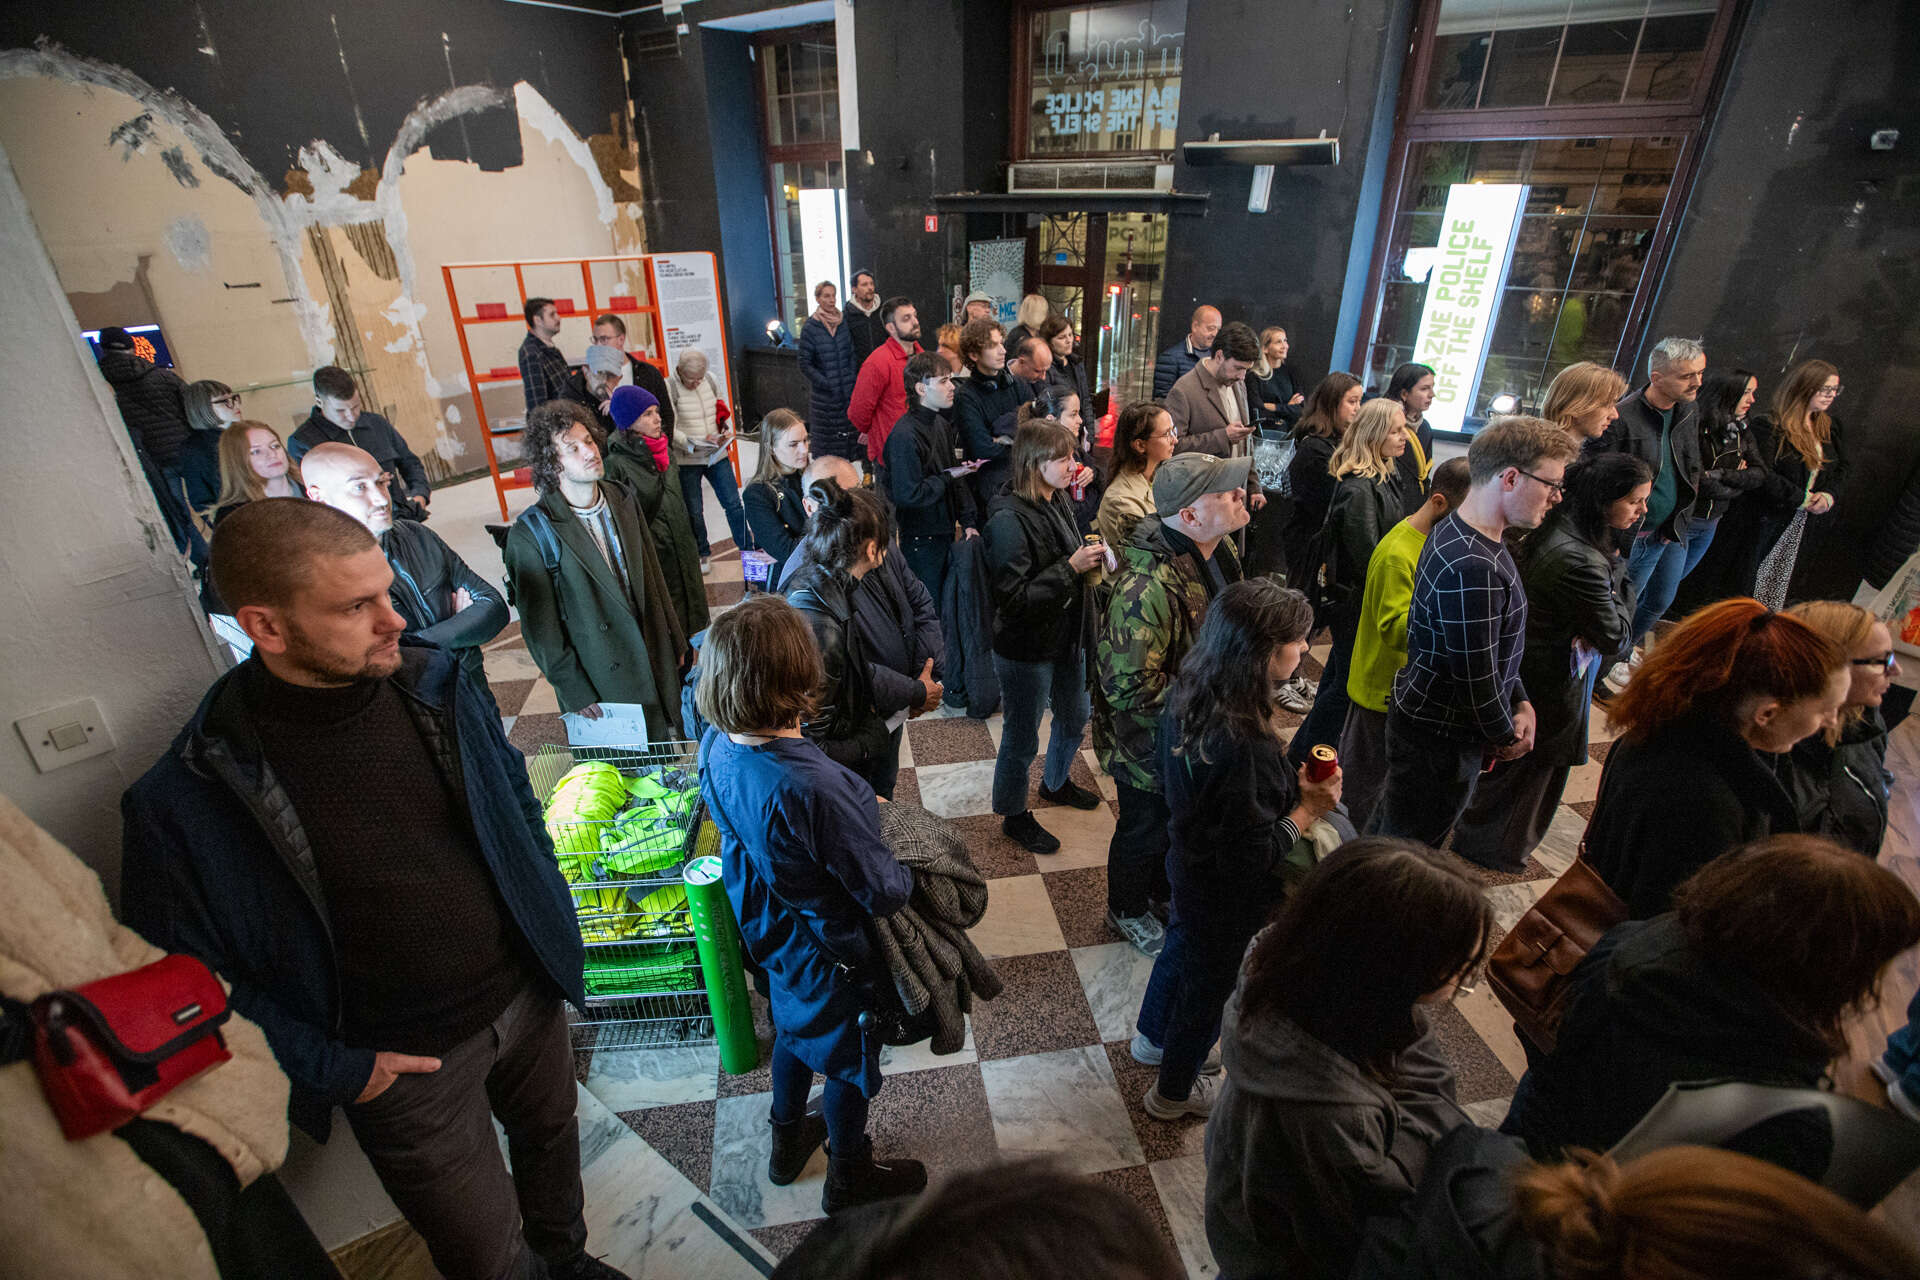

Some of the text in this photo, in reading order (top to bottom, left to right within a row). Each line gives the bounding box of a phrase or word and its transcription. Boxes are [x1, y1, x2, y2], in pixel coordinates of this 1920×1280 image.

[1433, 236, 1493, 403] OFF THE SHELF
[1436, 219, 1475, 301] POLICE
